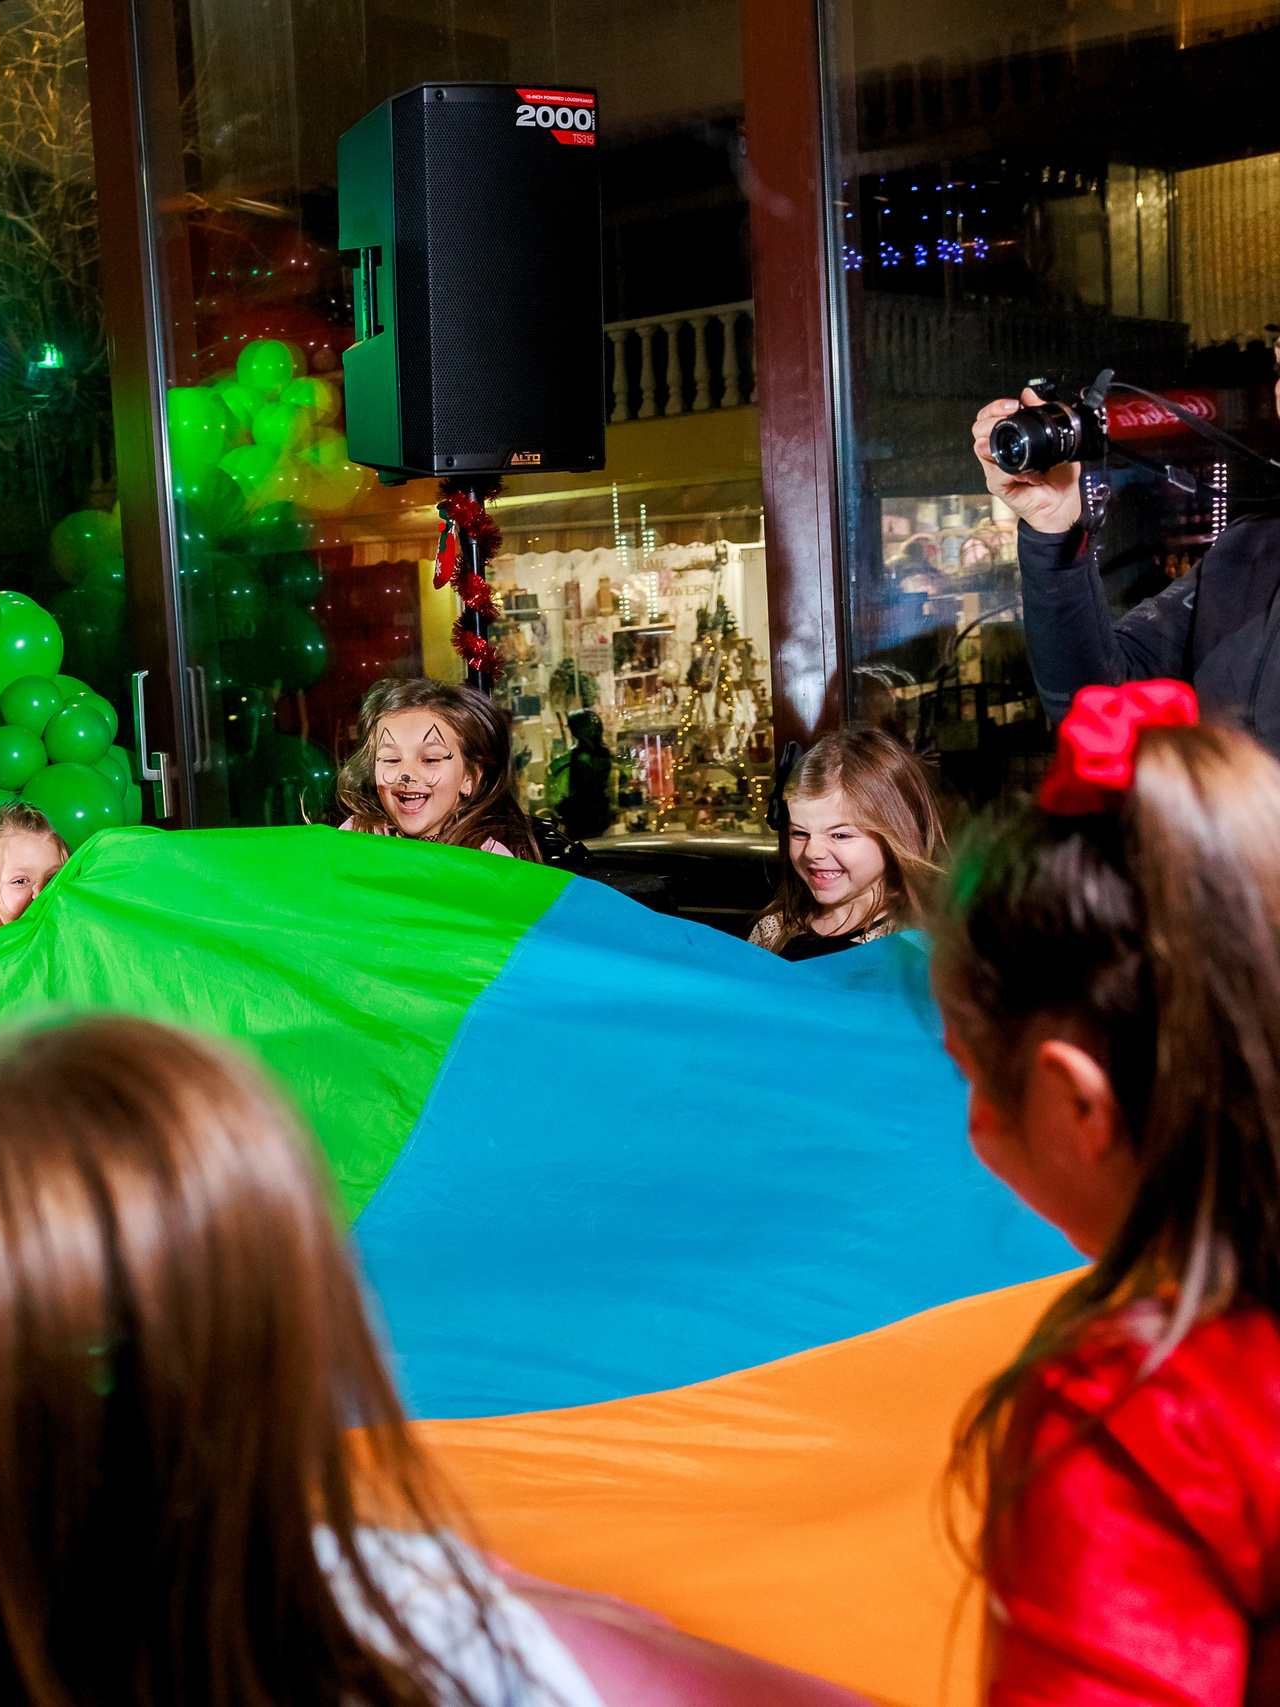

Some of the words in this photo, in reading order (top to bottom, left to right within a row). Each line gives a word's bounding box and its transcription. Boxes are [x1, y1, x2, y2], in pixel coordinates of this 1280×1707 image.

[516, 105, 591, 130] 2000
[572, 133, 594, 145] TS315
[511, 452, 541, 462] ALTO
